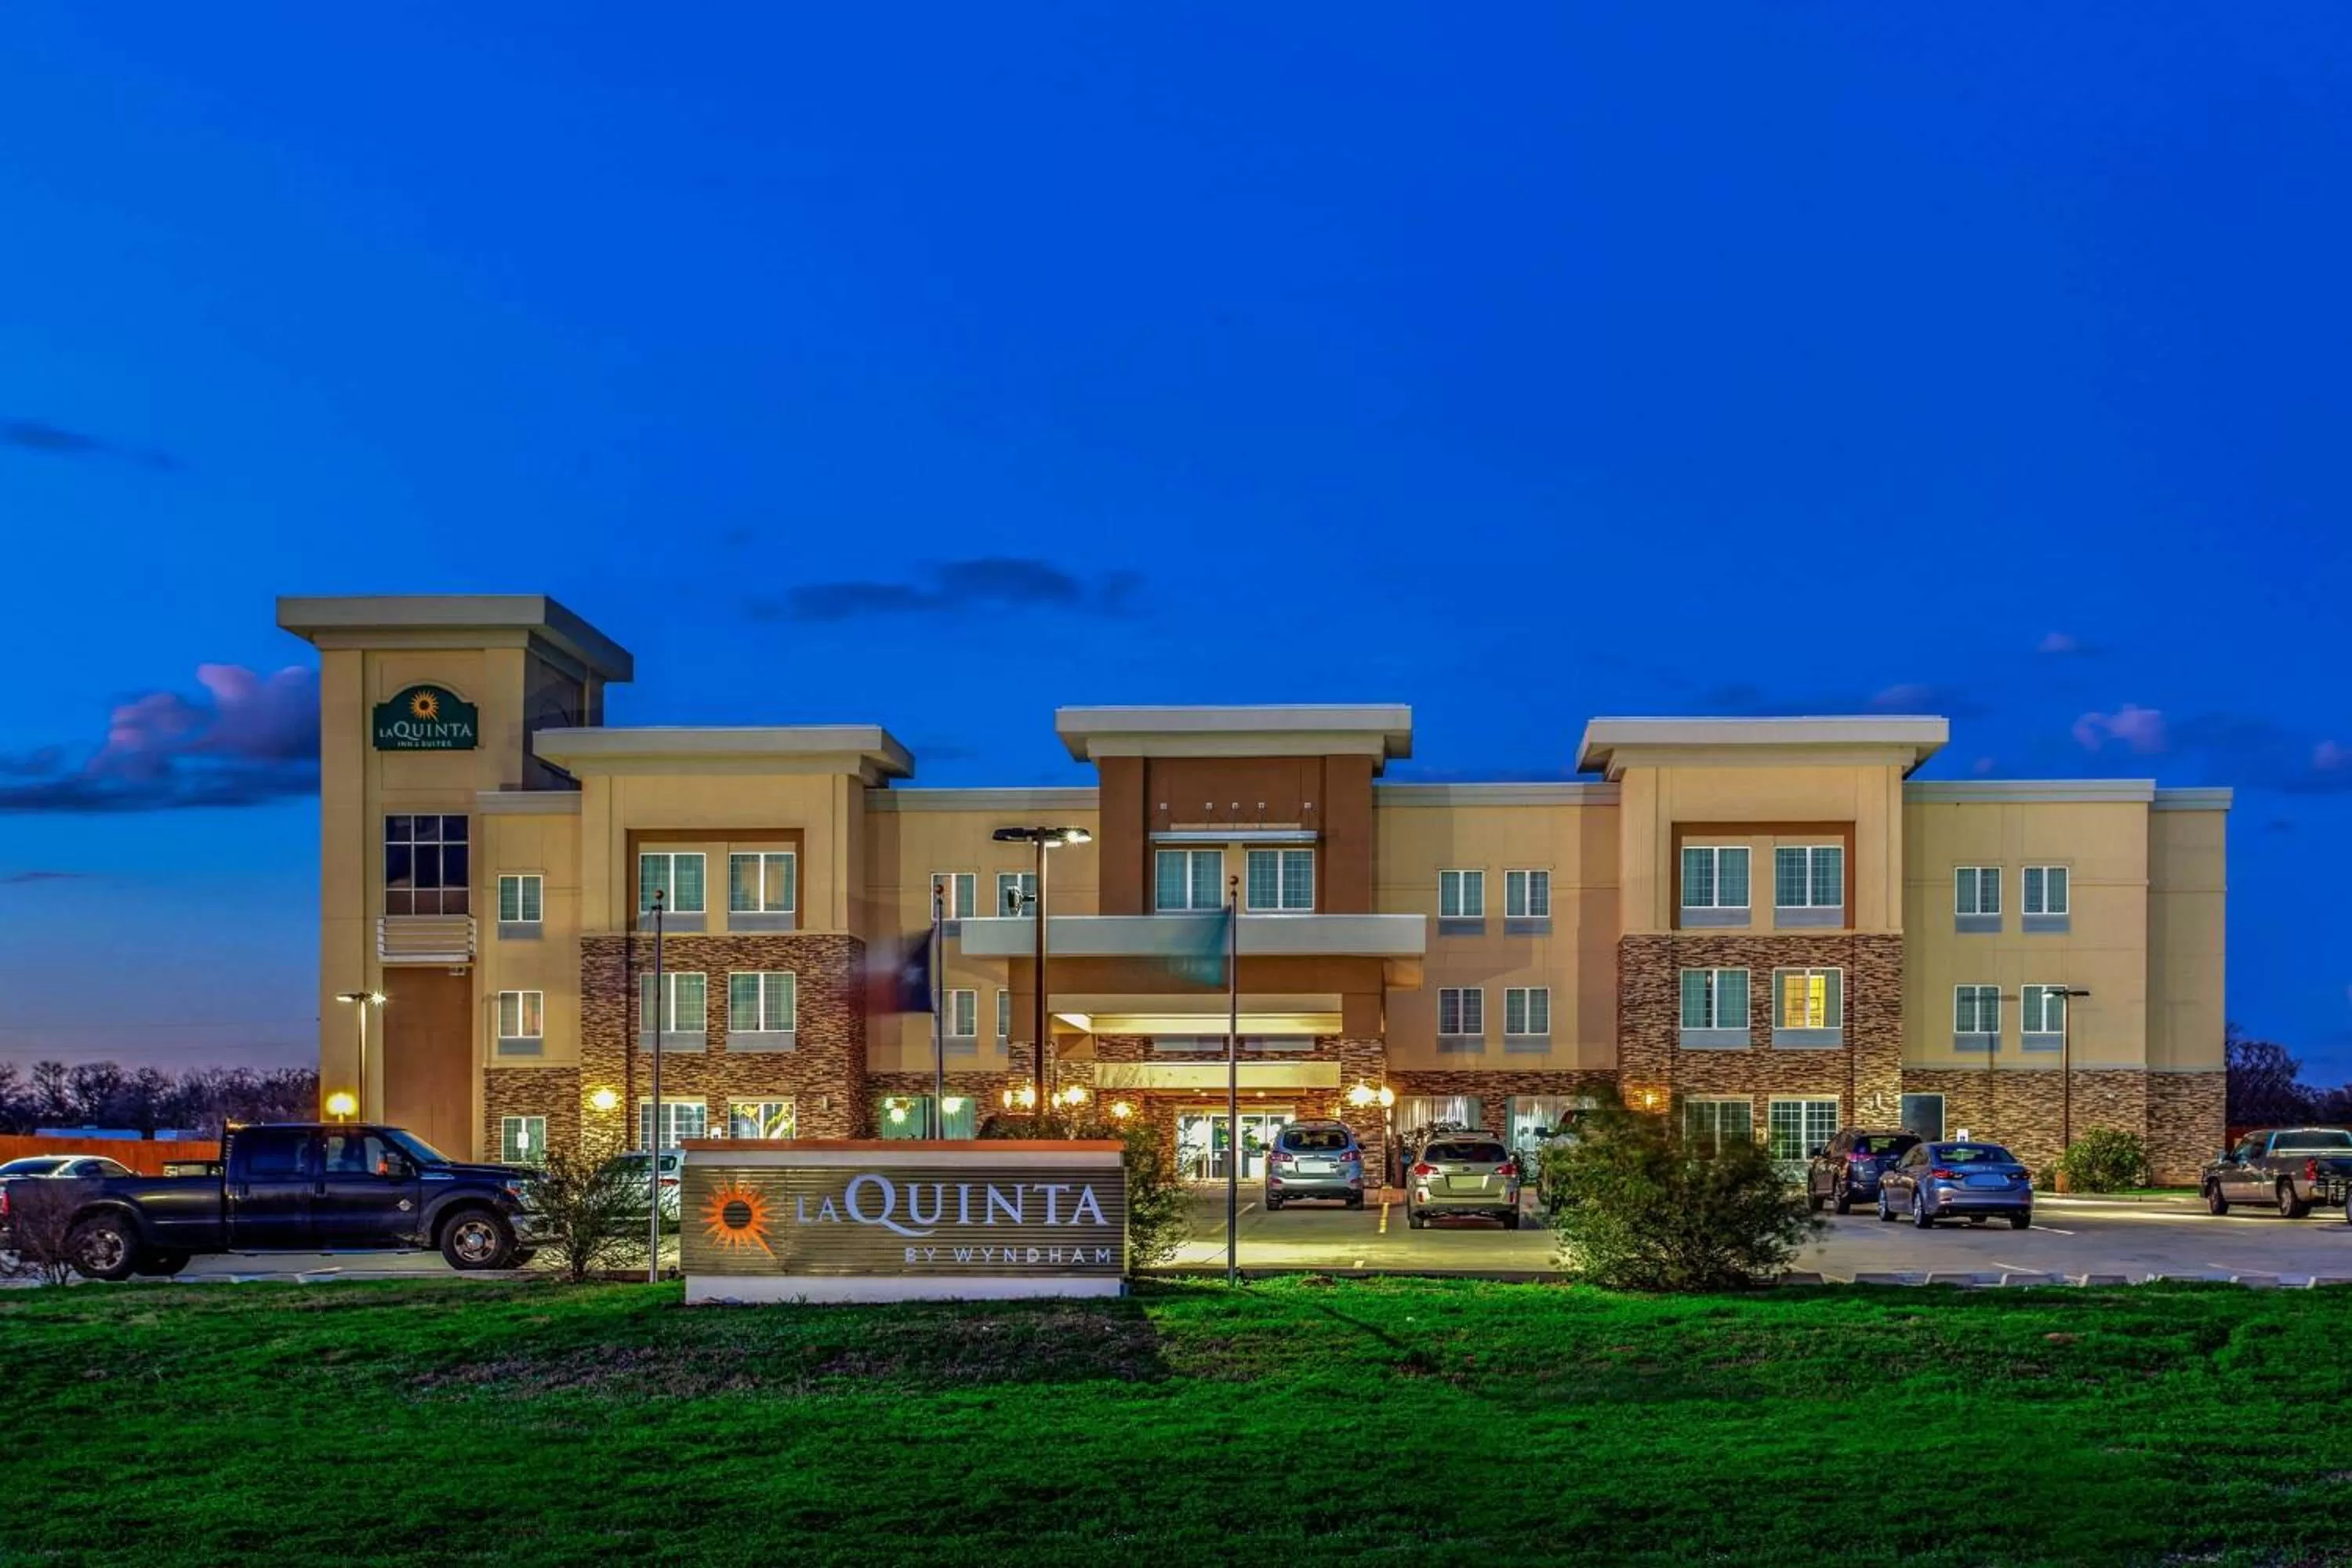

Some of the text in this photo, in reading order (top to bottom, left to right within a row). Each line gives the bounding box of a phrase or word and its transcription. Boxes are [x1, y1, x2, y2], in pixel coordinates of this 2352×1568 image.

[379, 720, 473, 741] LA QUINTA
[796, 1173, 1109, 1237] LA QUINTA
[905, 1247, 1112, 1264] BY WYNDHAM
